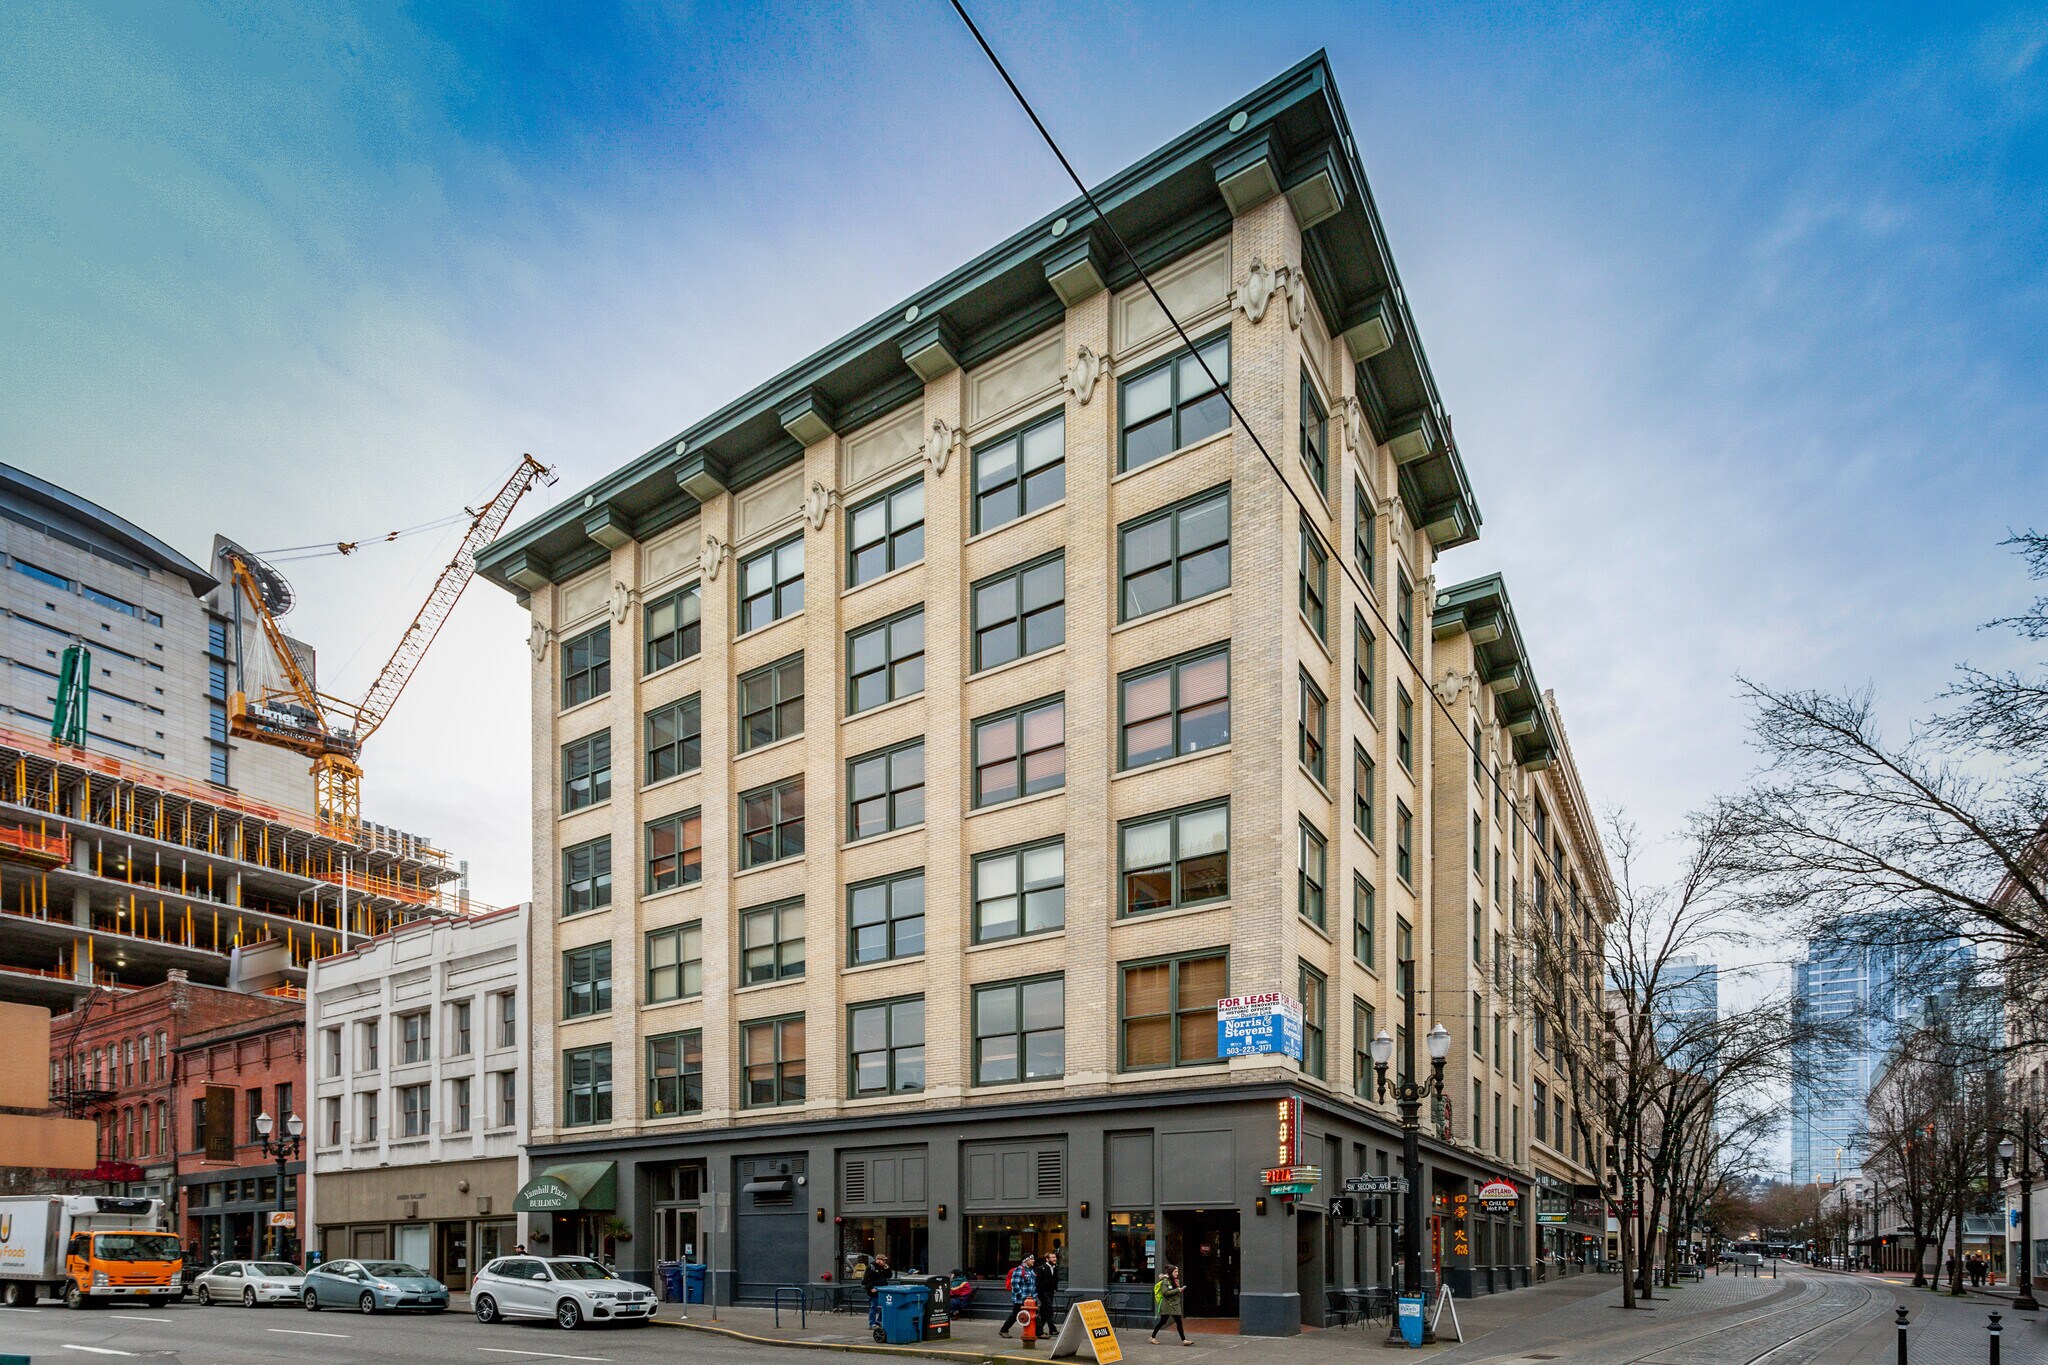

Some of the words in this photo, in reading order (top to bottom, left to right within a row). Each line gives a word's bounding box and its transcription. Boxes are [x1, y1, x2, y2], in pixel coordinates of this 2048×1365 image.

[250, 703, 298, 725] Turner
[273, 728, 312, 742] MORROW
[1219, 999, 1240, 1008] FOR
[1245, 993, 1279, 1005] LEASE
[1225, 1018, 1261, 1029] Norris
[1262, 1014, 1272, 1027] &
[1225, 1026, 1273, 1038] Stevens
[1226, 1044, 1272, 1054] 503-223-3171
[1266, 1169, 1291, 1183] PIZZA
[524, 1185, 549, 1199] Yamhill
[550, 1185, 568, 1200] Plaza
[529, 1198, 561, 1207] BUILDING
[1094, 1328, 1108, 1337] PAIN
